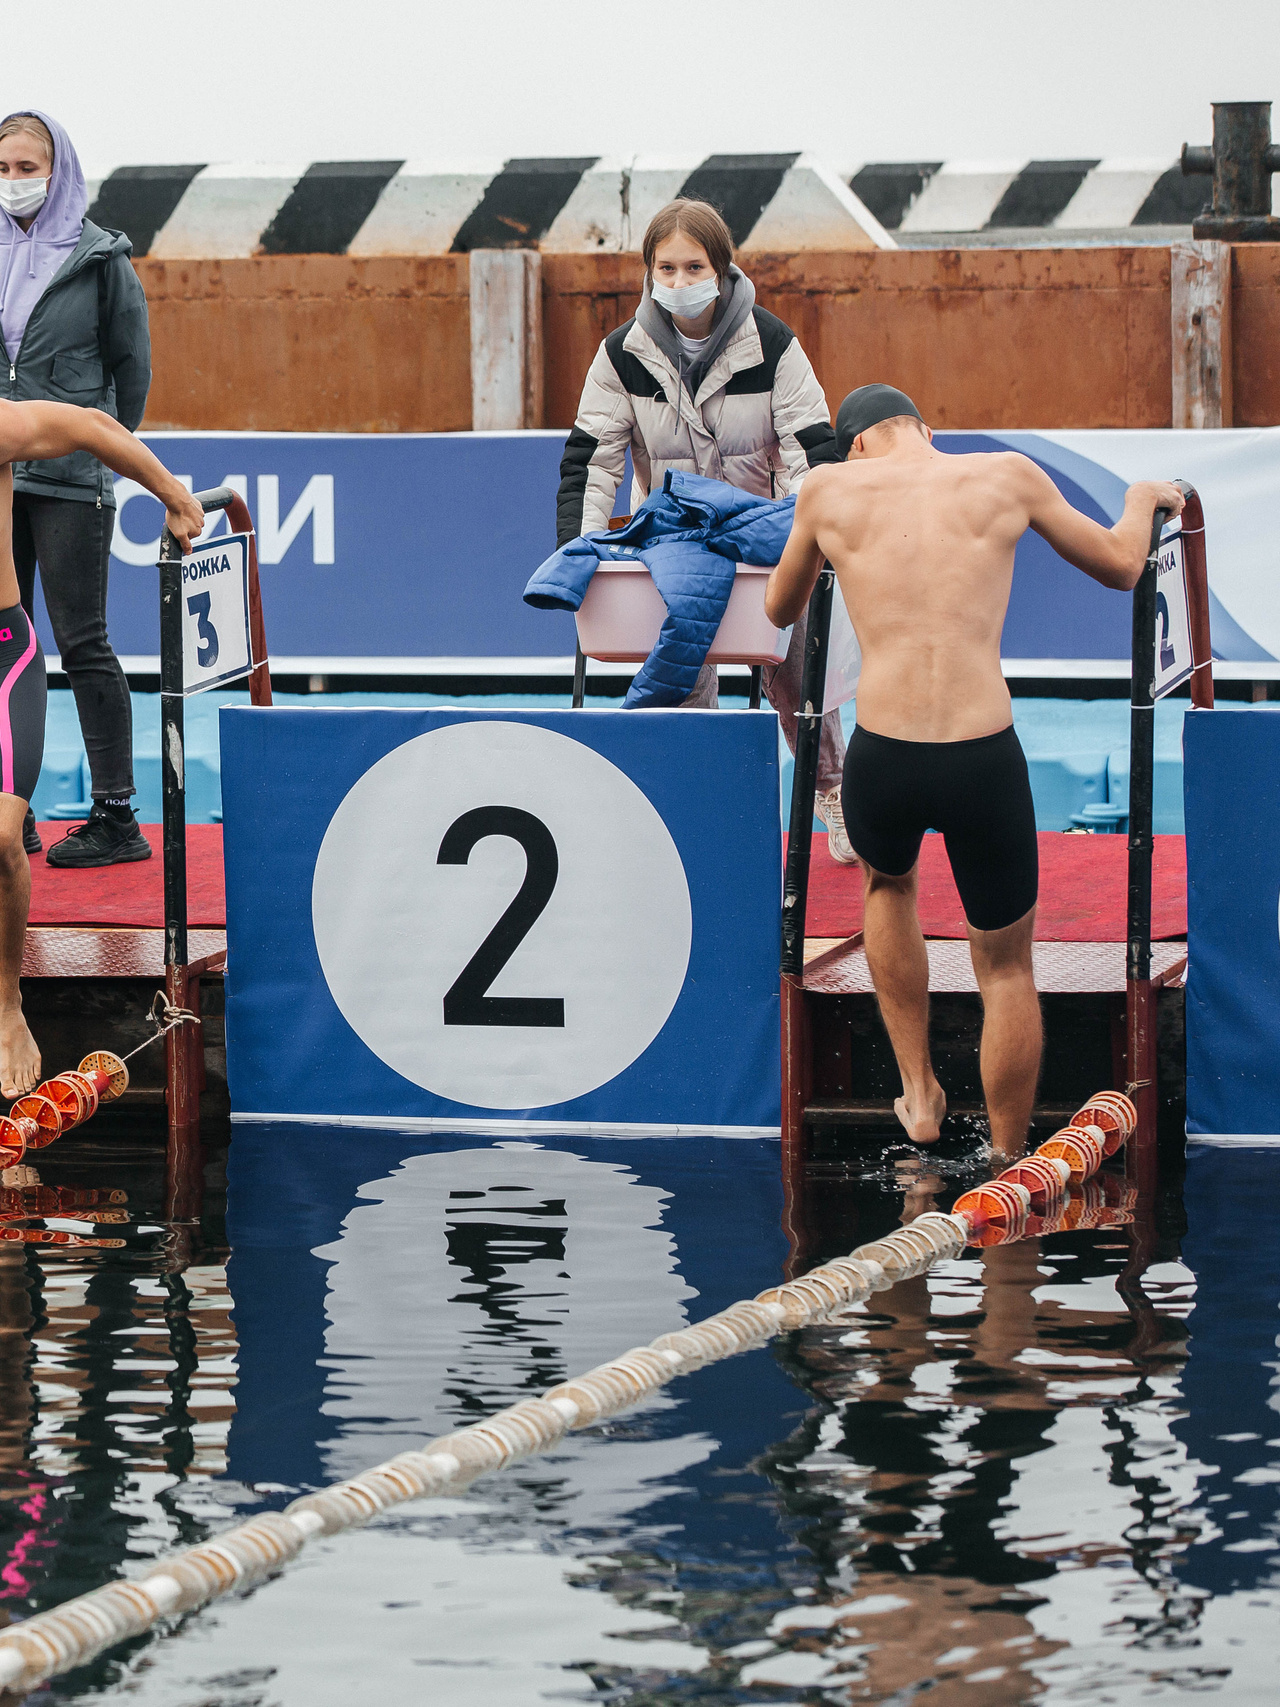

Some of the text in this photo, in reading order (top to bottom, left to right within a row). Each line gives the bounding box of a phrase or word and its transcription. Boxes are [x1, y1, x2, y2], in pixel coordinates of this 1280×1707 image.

[186, 590, 219, 668] 3
[1156, 591, 1176, 672] 2
[436, 805, 565, 1027] 2
